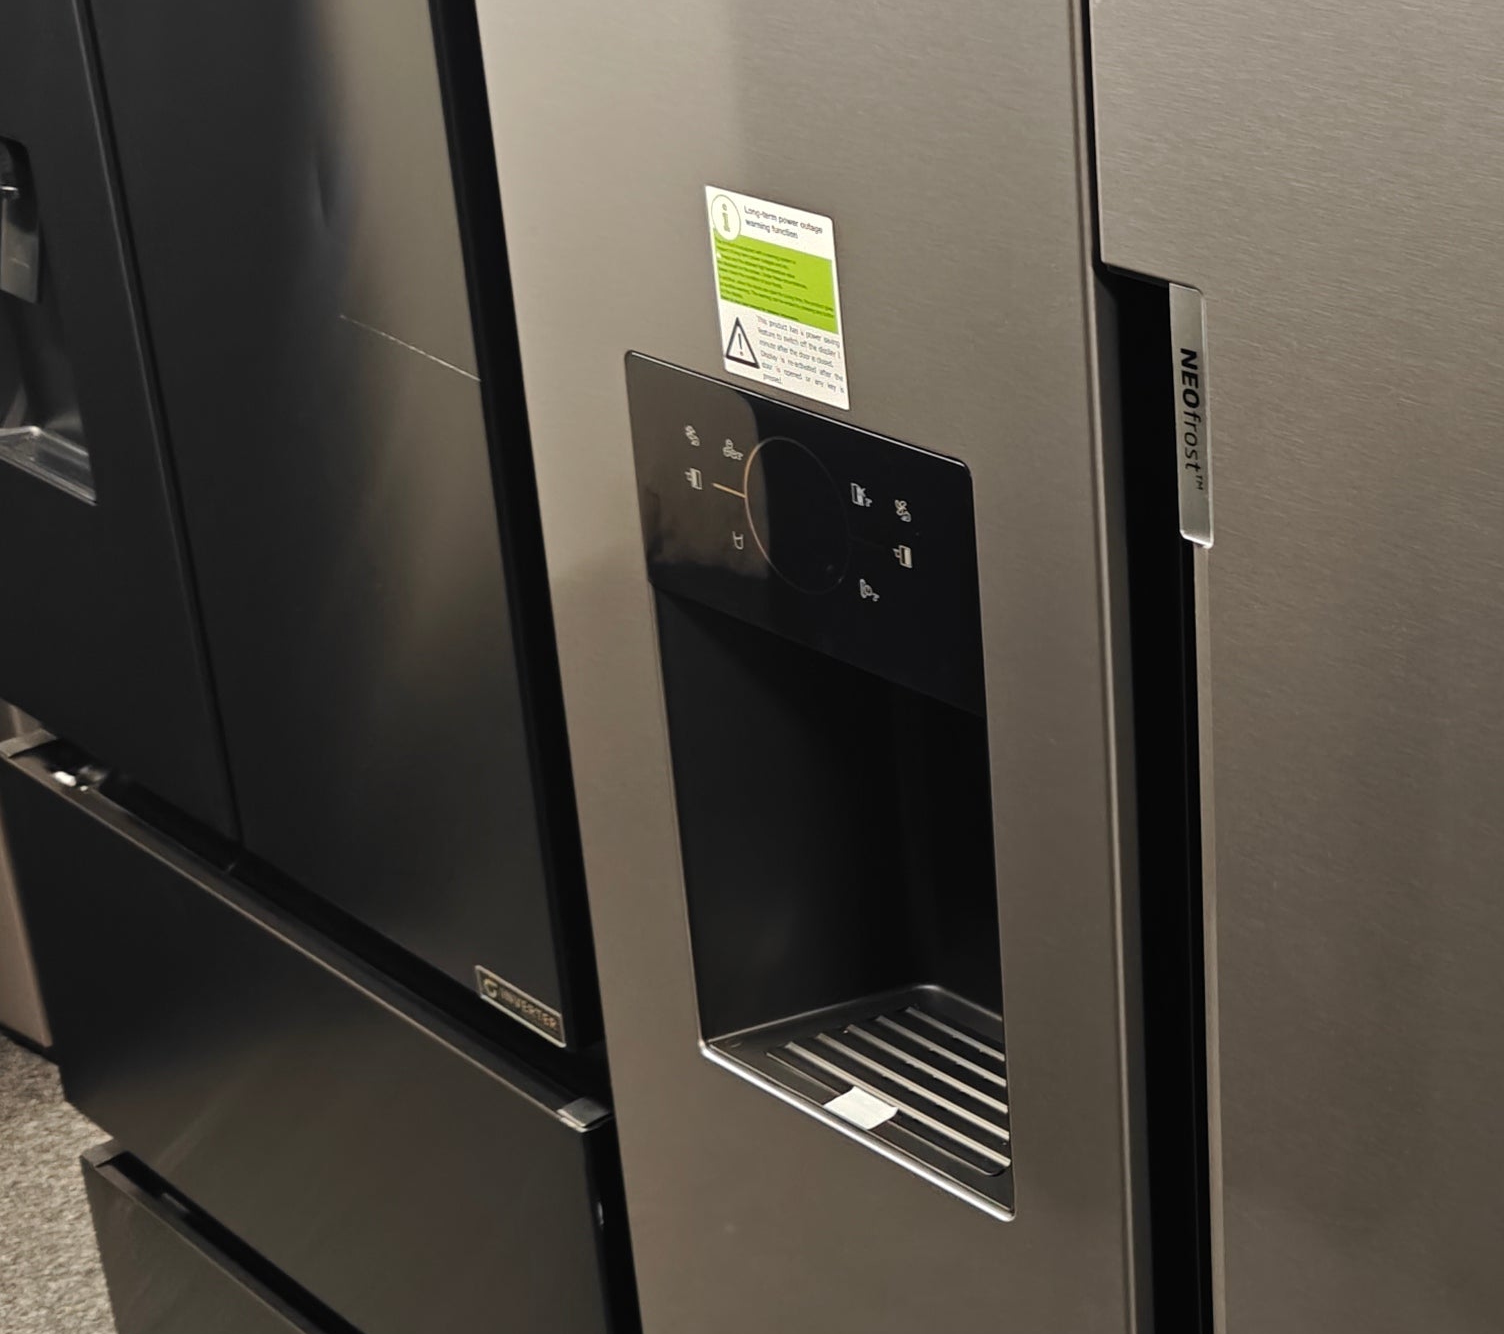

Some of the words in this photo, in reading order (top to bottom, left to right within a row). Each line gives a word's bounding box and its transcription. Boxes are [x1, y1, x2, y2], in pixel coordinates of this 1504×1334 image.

[744, 205, 777, 222] Long-term
[779, 216, 799, 228] power
[800, 221, 823, 235] outage
[745, 219, 771, 234] warning
[772, 225, 799, 240] function
